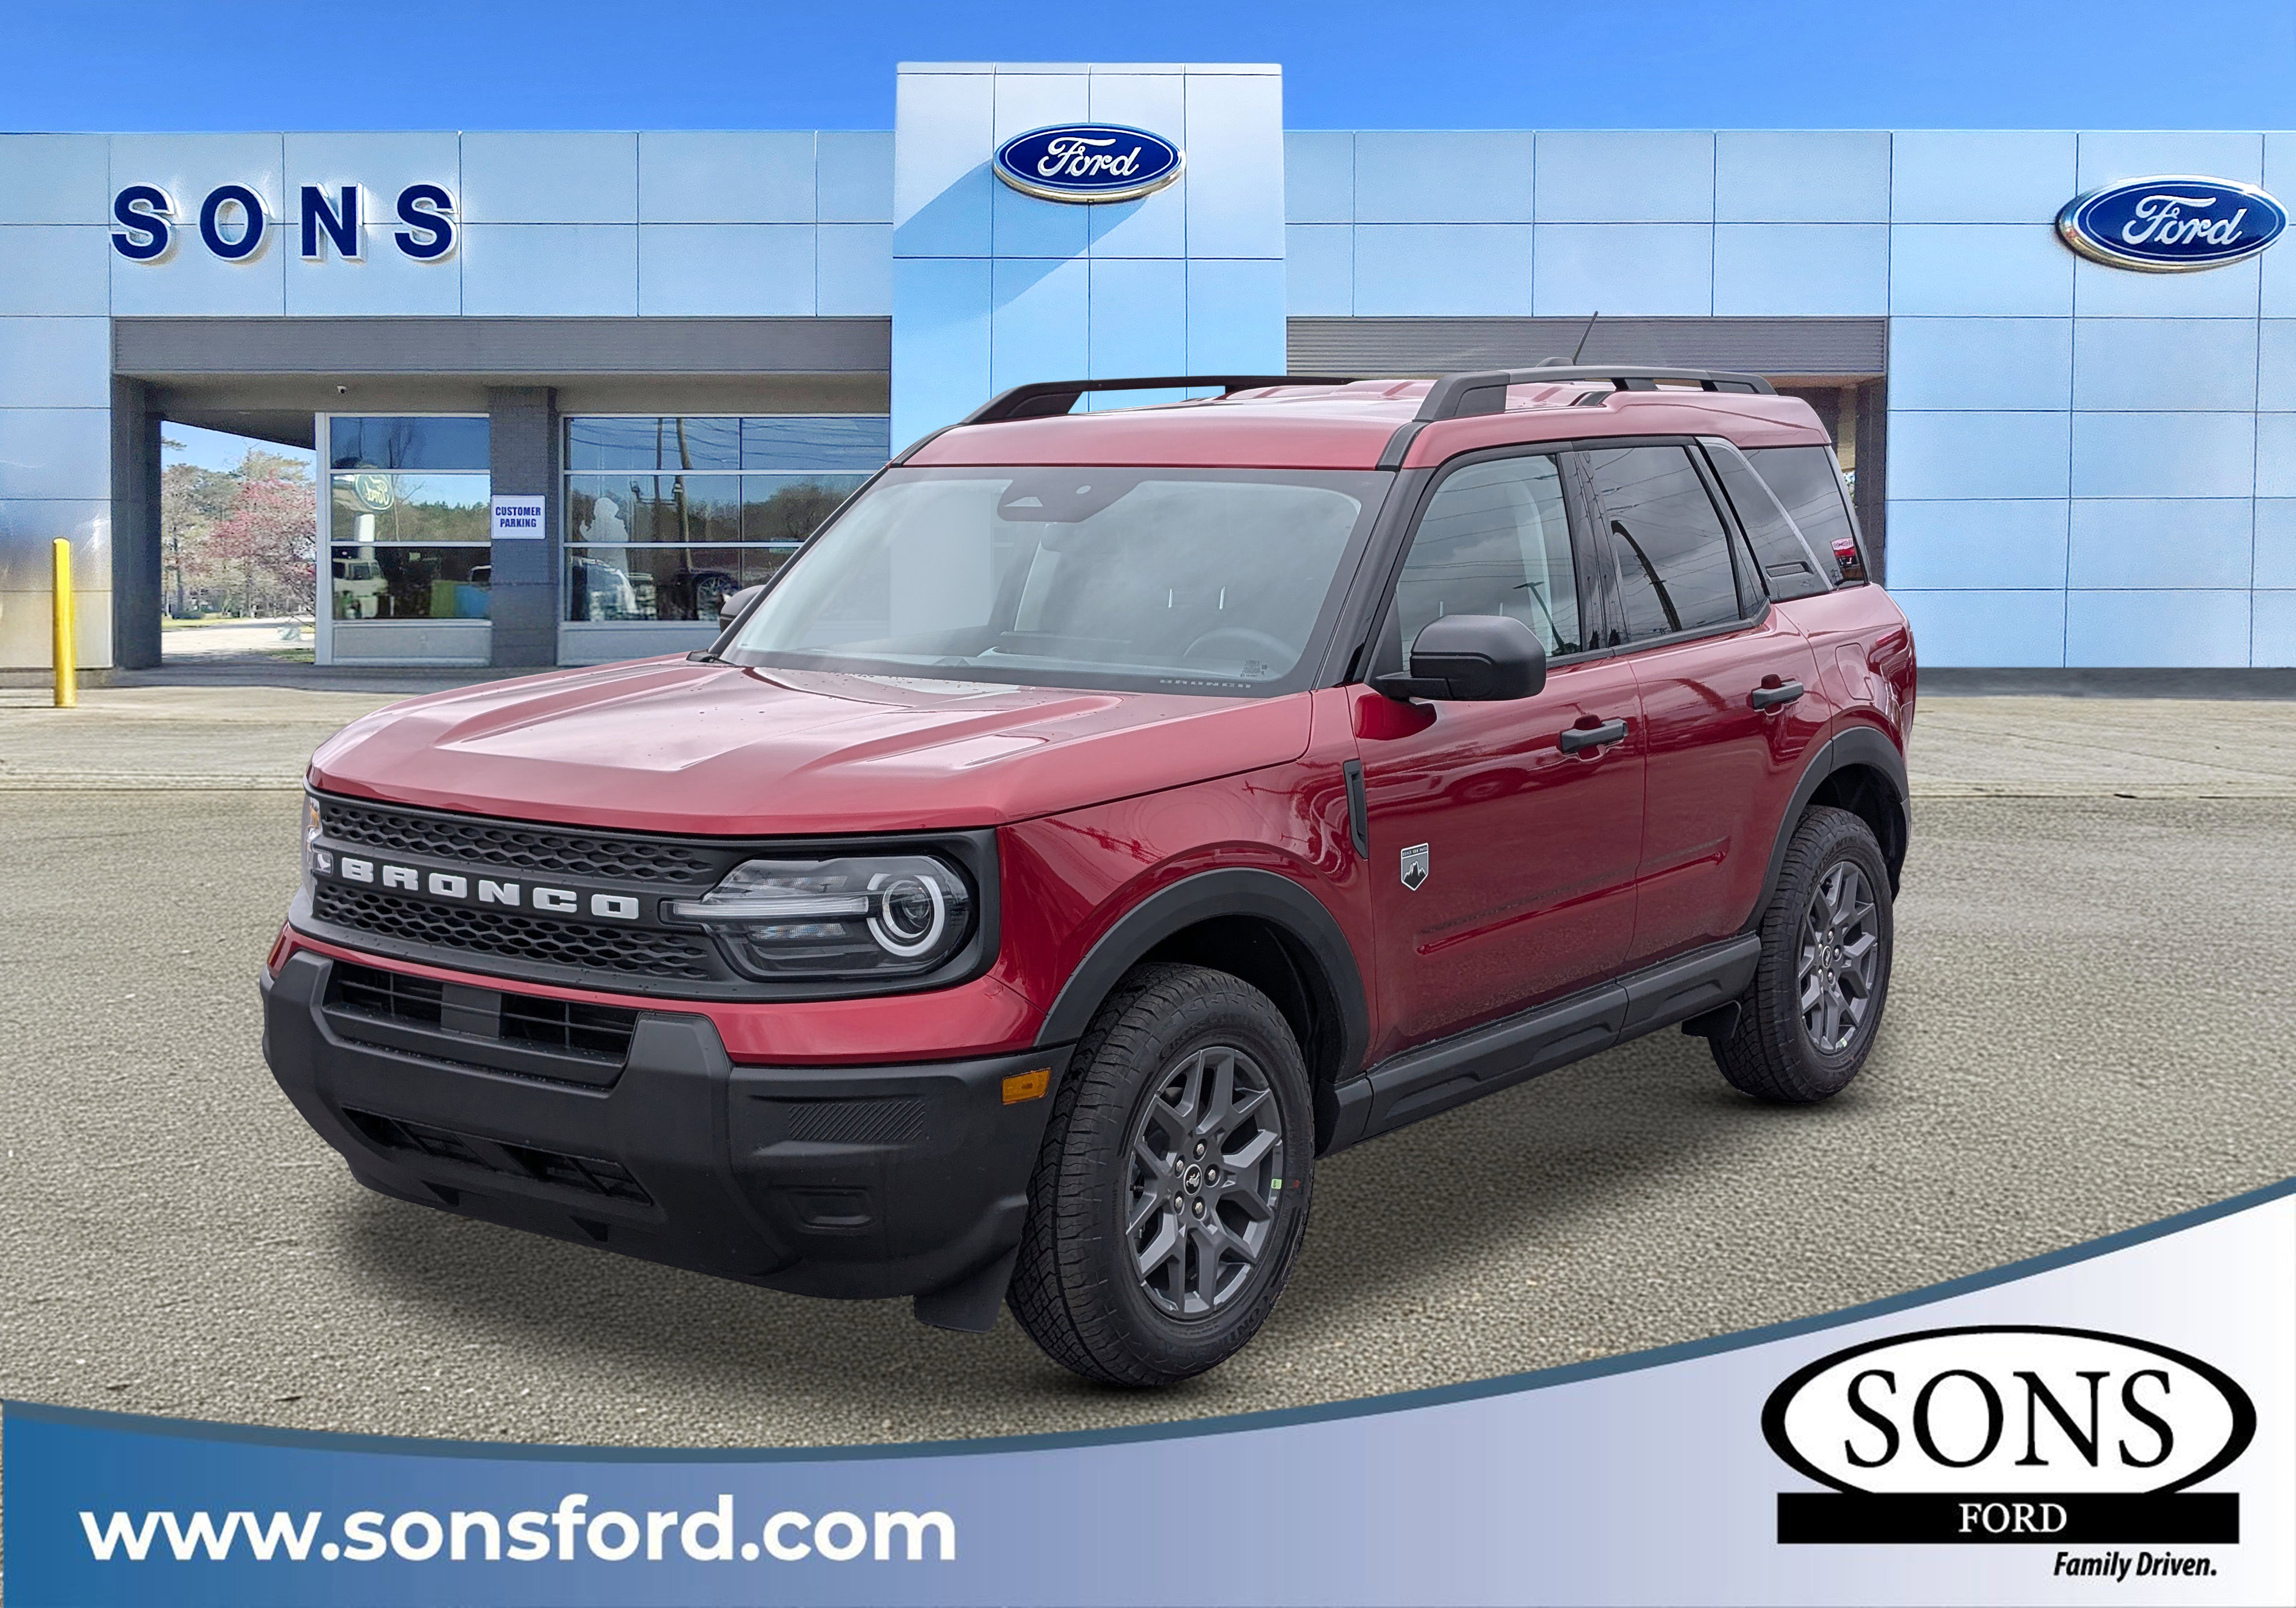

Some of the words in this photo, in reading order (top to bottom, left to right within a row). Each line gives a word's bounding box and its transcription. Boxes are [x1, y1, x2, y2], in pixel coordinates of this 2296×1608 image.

[1037, 137, 1142, 177] Ford
[111, 182, 458, 261] SONS
[2122, 195, 2247, 245] Ford
[495, 506, 541, 516] CUSTOMER
[500, 518, 537, 527] PARKING
[342, 857, 639, 919] BRONCO
